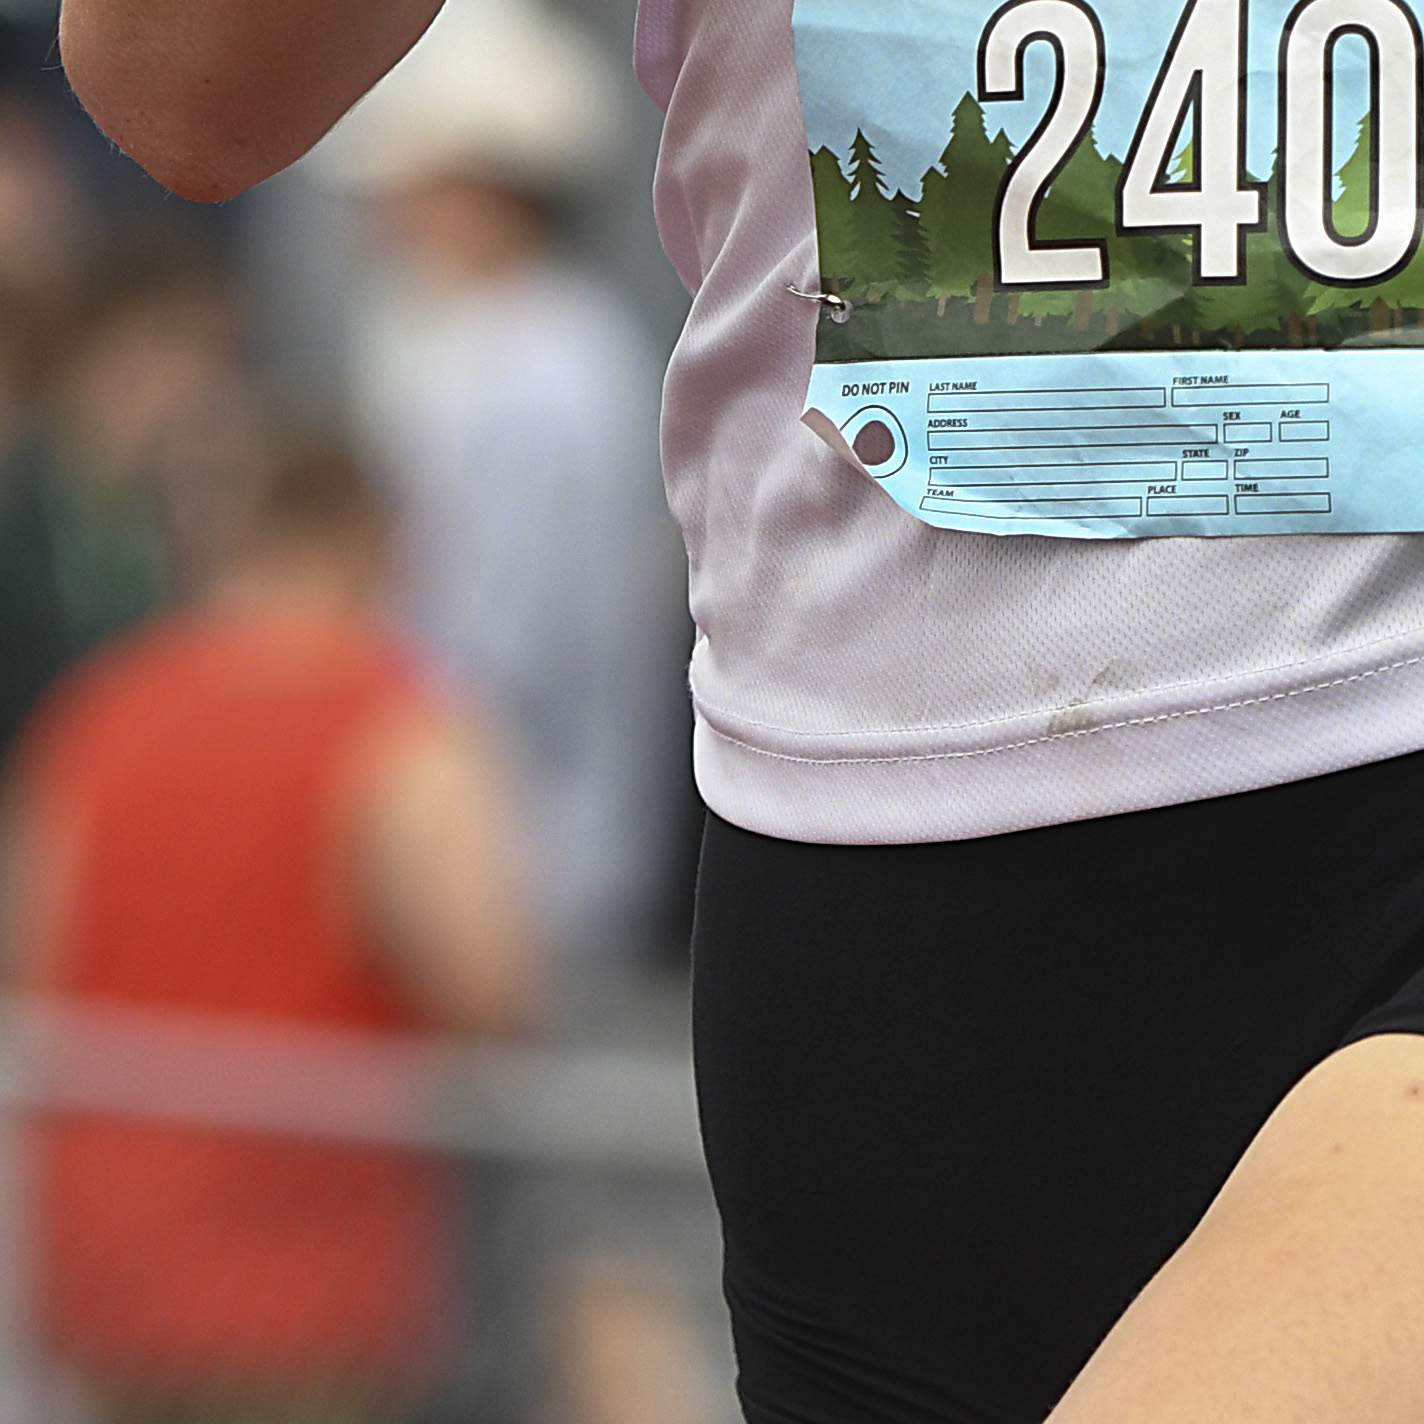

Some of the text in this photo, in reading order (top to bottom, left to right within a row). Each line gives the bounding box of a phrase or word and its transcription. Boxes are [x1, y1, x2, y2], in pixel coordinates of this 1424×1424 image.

[1172, 375, 1229, 385] FIRST NAME
[841, 381, 910, 397] DO NOT PIN
[929, 381, 978, 392] LAST NAME
[1222, 412, 1241, 421] SEX
[1279, 409, 1301, 419] AGE
[927, 418, 968, 428] ADDRESS
[1182, 448, 1210, 458] STATE
[1233, 448, 1250, 457] ZIP
[929, 455, 949, 465] CITY
[926, 488, 954, 497] TEAM
[1147, 485, 1177, 495] PLACE
[1234, 483, 1259, 493] TIME
